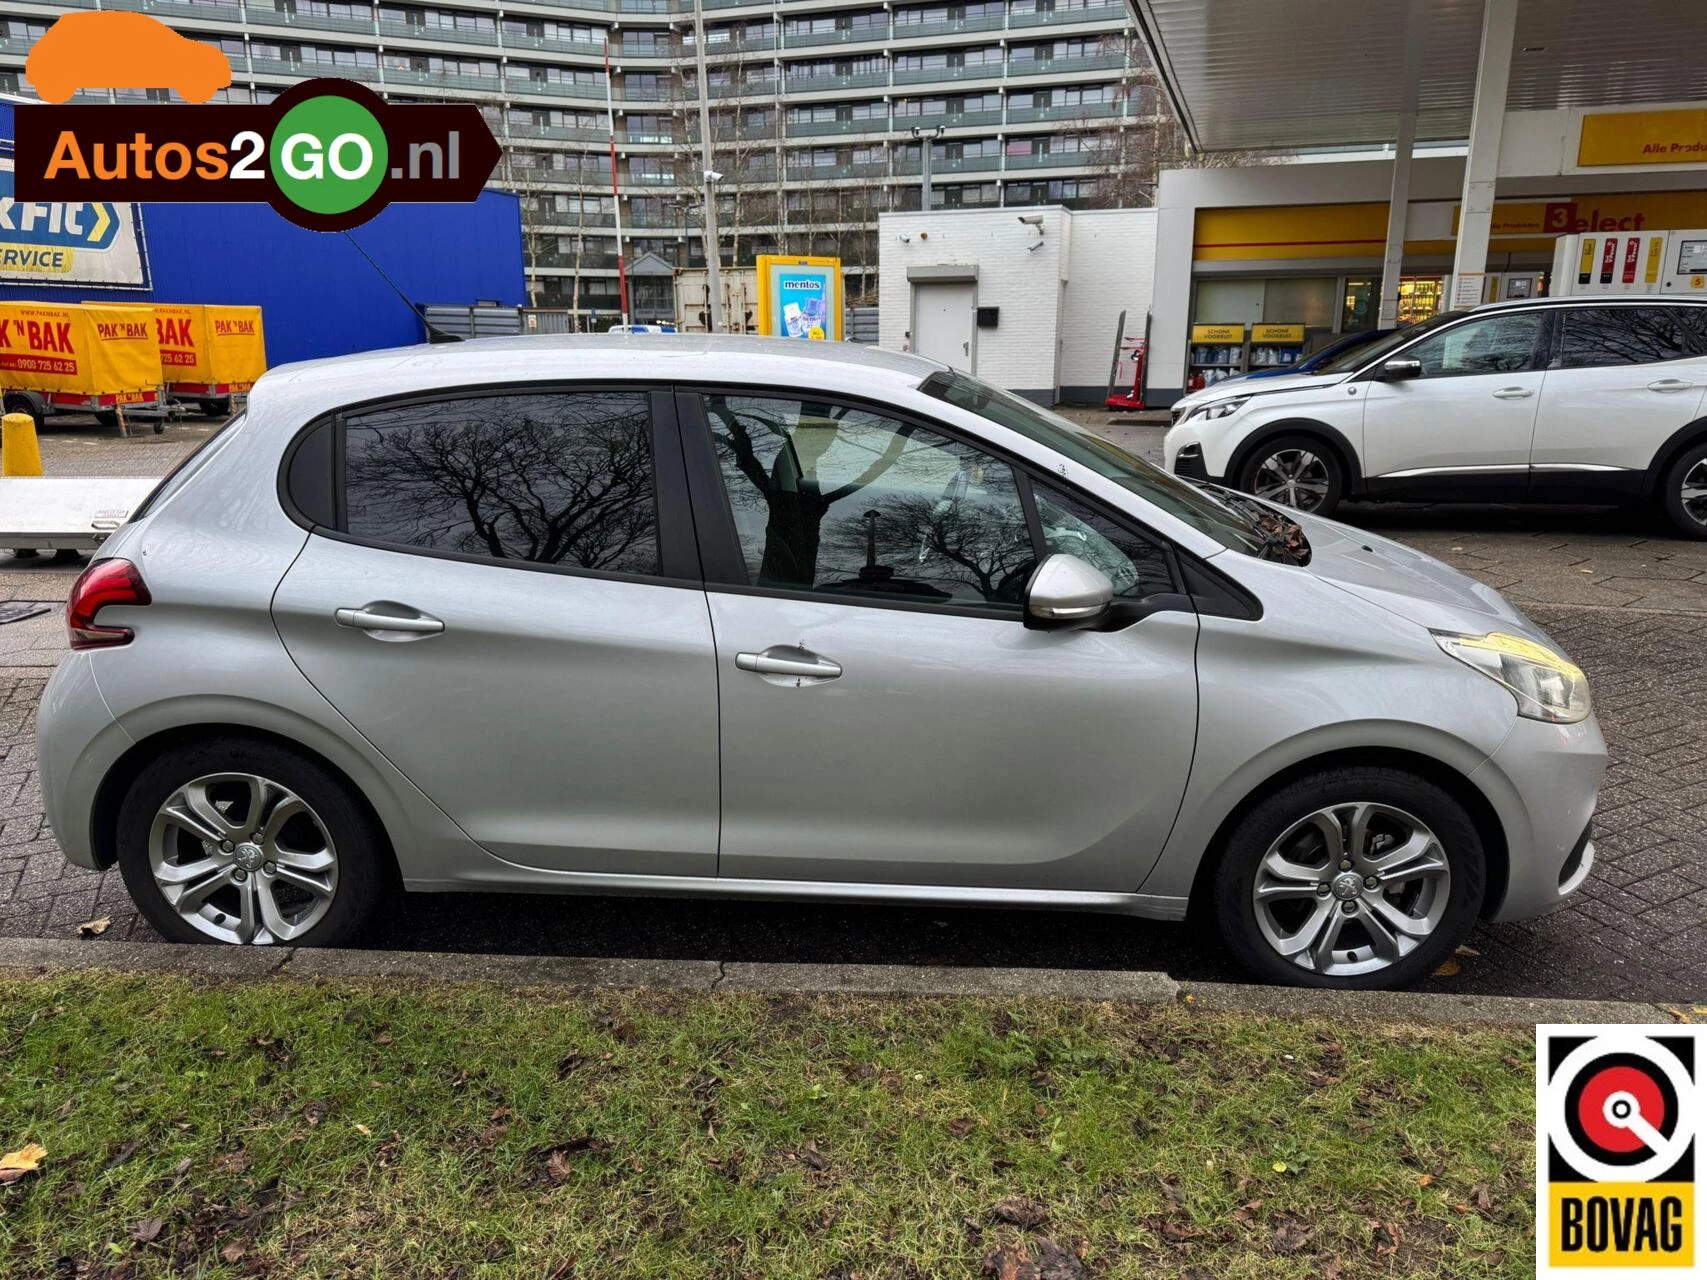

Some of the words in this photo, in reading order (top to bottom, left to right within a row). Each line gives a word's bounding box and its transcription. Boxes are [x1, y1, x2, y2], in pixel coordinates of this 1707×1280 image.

[1642, 144, 1667, 153] Alle
[1552, 208, 1568, 228] 3
[0, 249, 63, 267] RVICE
[784, 280, 820, 289] mentos
[1694, 278, 1701, 286] 5
[97, 323, 117, 337] PAK
[126, 322, 147, 337] BAK
[215, 320, 232, 333] PAK
[238, 320, 255, 333] BAK
[27, 321, 74, 354] BAK
[17, 359, 36, 369] 0900
[37, 360, 51, 370] 725
[53, 361, 63, 371] 62
[64, 362, 75, 372] 25
[184, 355, 195, 364] 25
